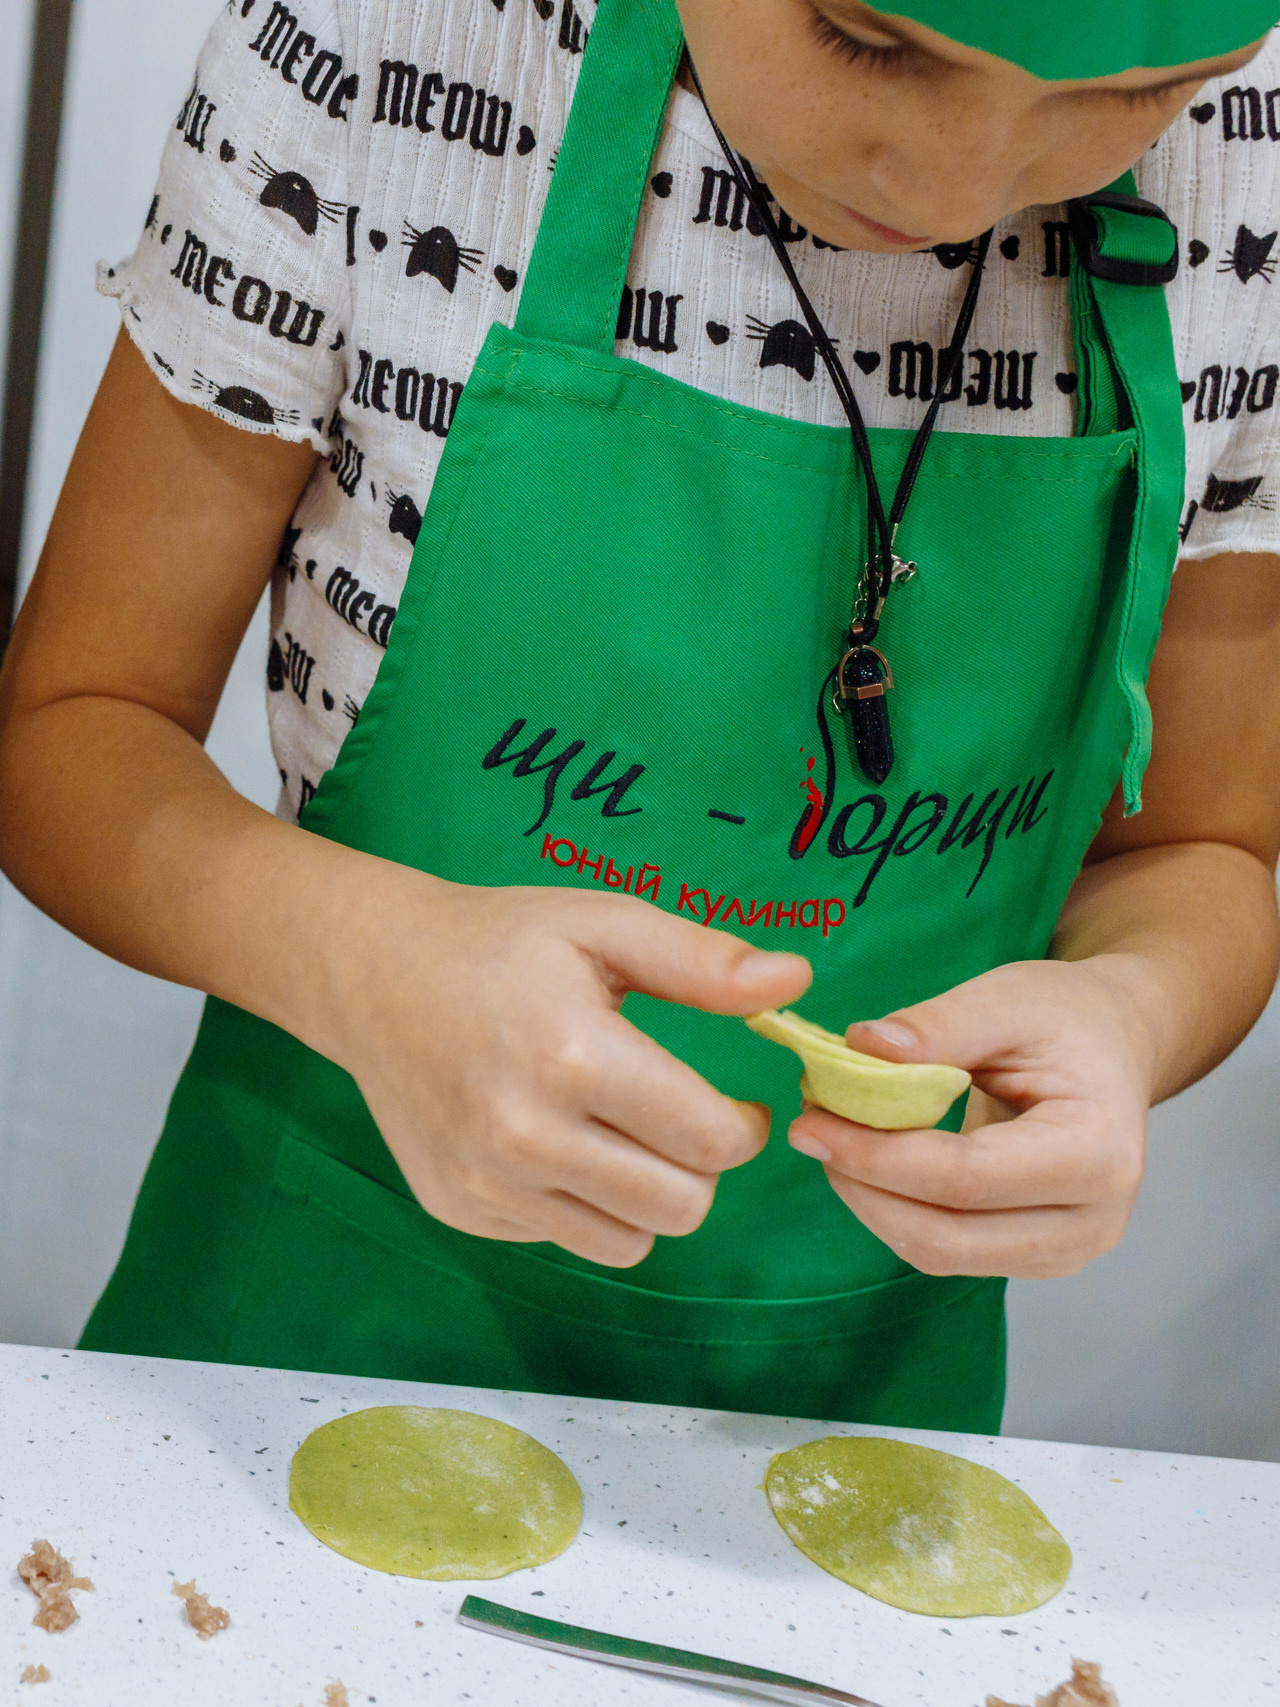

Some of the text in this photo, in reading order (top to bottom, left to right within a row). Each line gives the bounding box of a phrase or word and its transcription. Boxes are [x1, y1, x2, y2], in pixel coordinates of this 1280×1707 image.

[372, 59, 512, 156] MEOW
[171, 229, 325, 347] MEOW
[325, 566, 397, 650] MEO
[540, 832, 847, 937] юный кулинар
